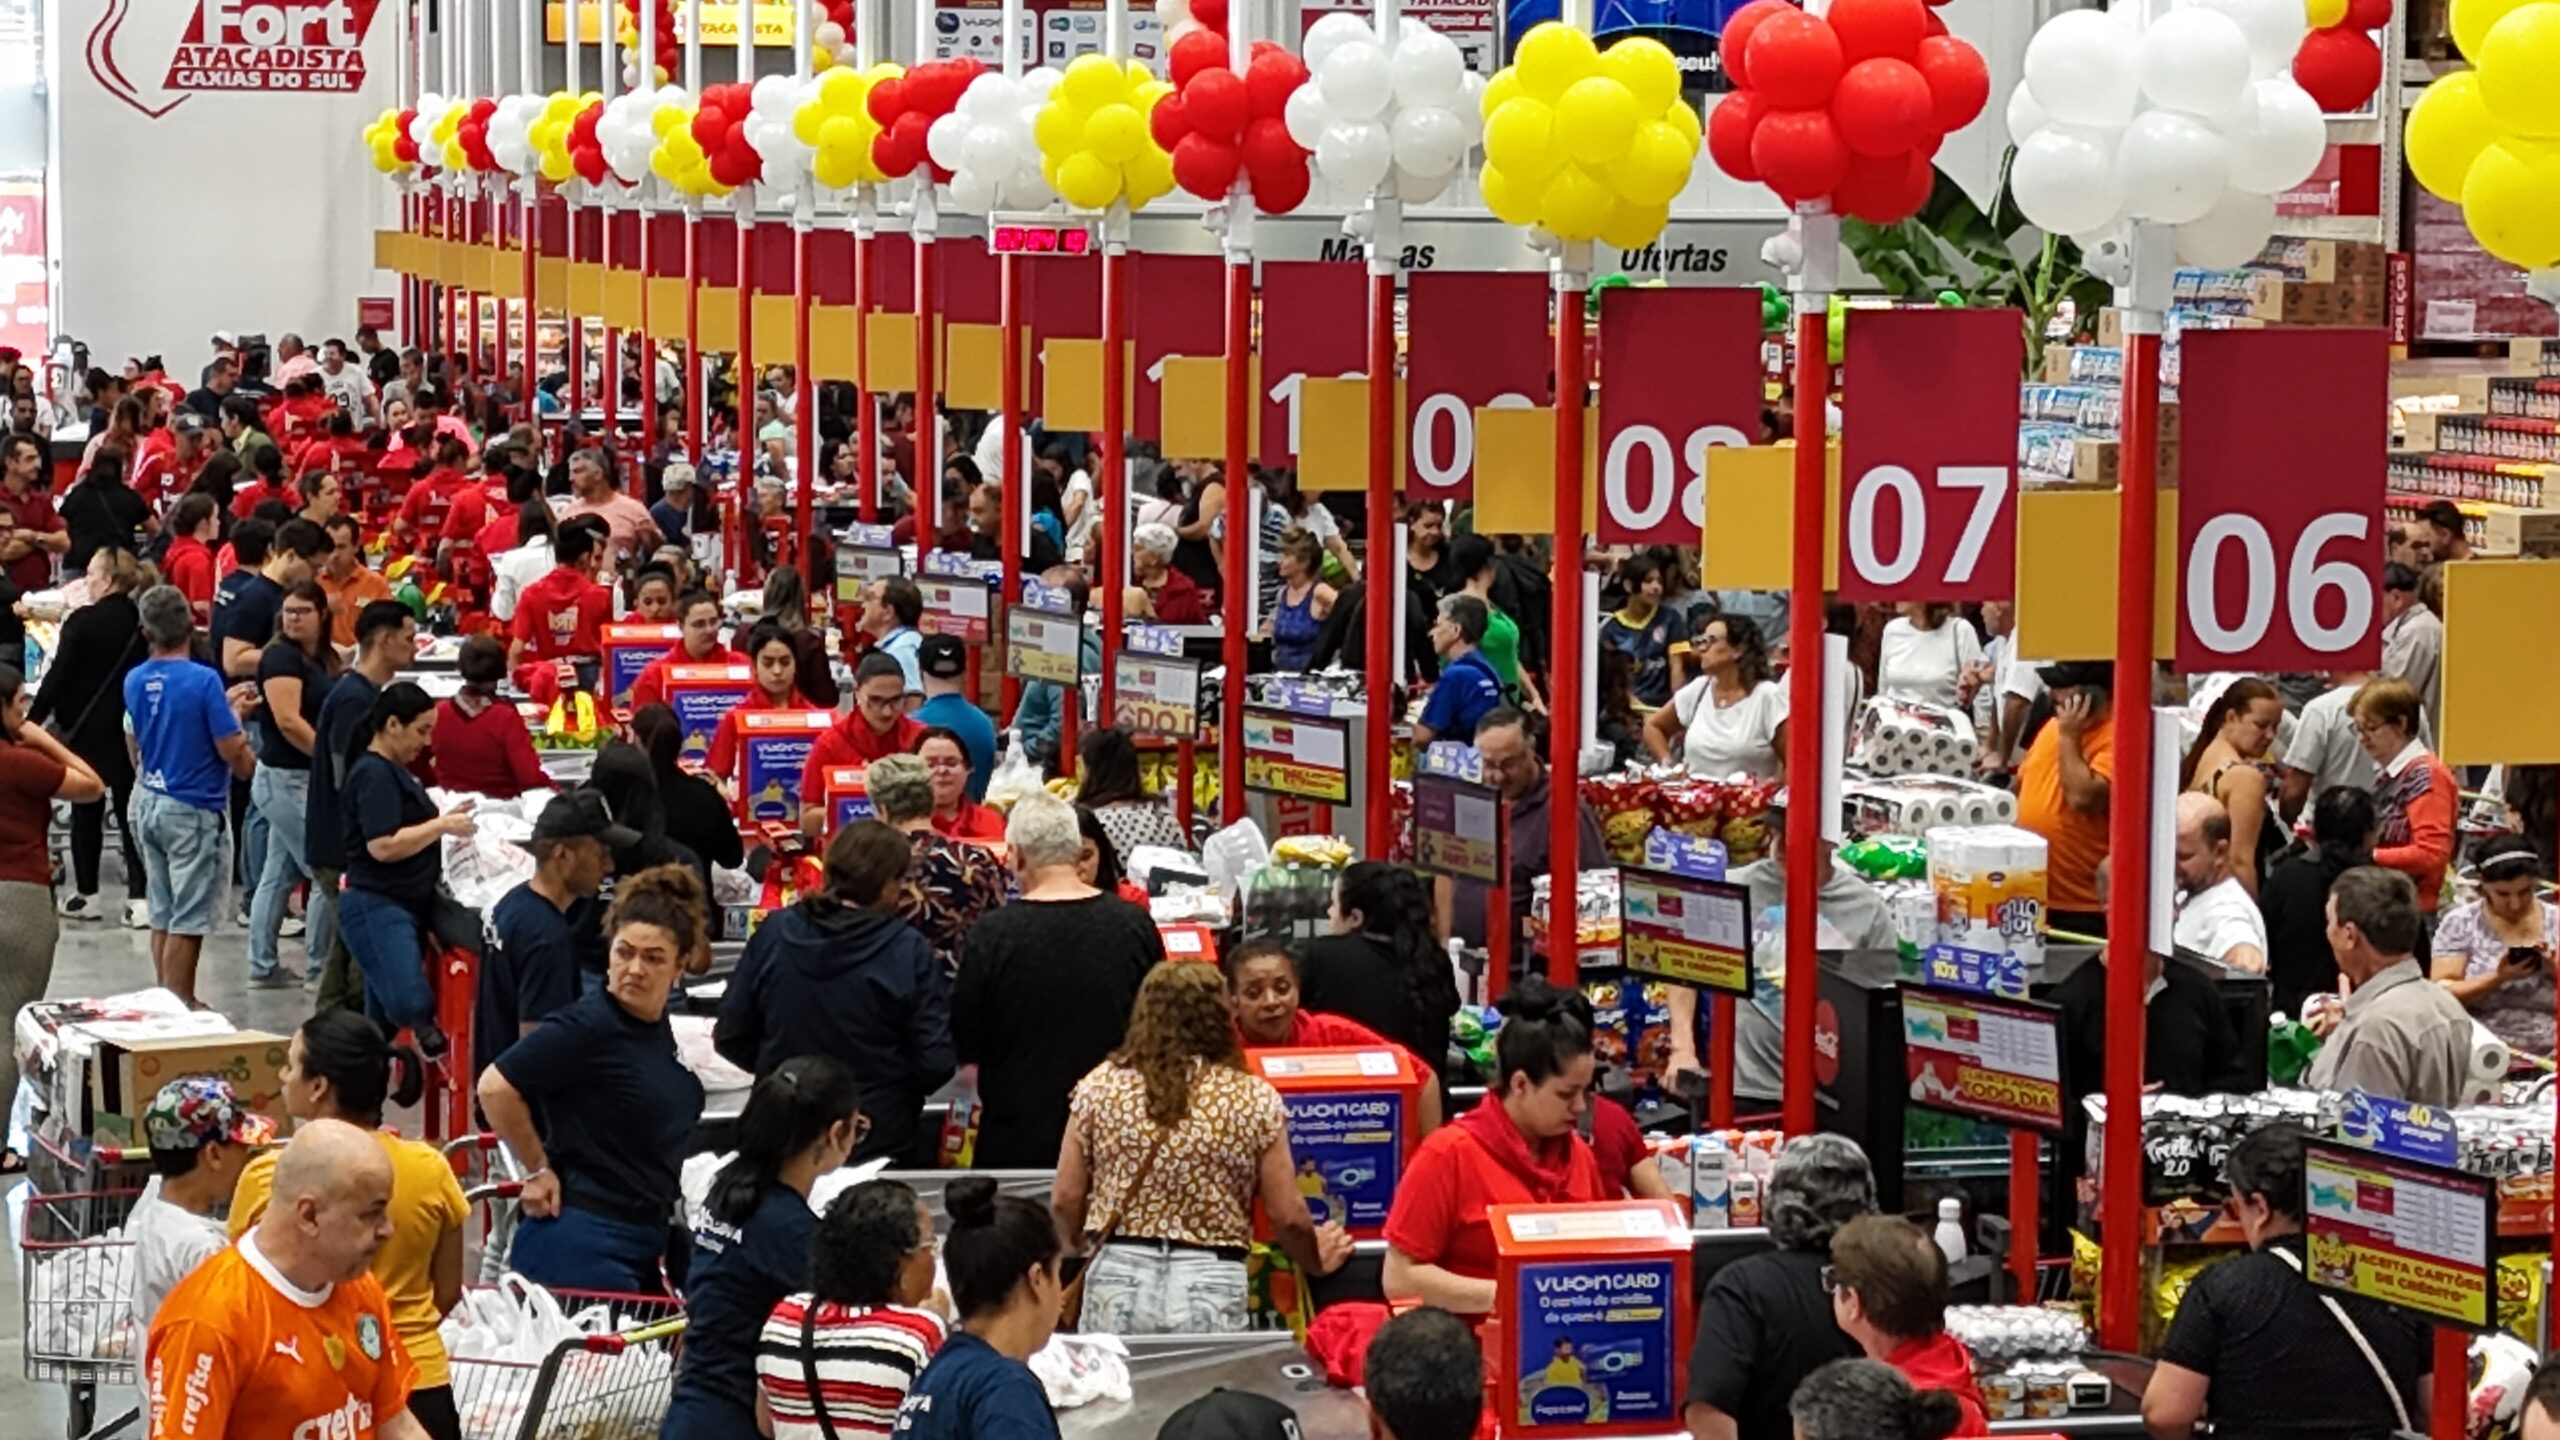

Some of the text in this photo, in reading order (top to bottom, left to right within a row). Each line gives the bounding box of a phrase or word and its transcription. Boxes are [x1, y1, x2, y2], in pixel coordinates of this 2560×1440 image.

[202, 0, 358, 47] Fort
[171, 46, 366, 70] ATACADISTA
[176, 70, 353, 89] CAXIAS DO SUL
[1320, 239, 1435, 268] Maas
[1412, 392, 1535, 487] 0
[1848, 464, 2011, 587] 07
[2186, 512, 2375, 654] 06
[2407, 1104, 2431, 1128] 40
[1612, 1272, 1661, 1290] CARD
[2359, 1252, 2485, 1293] ACEITA CARTÕES
[2374, 1271, 2395, 1287] DE
[182, 1352, 214, 1435] crefisa
